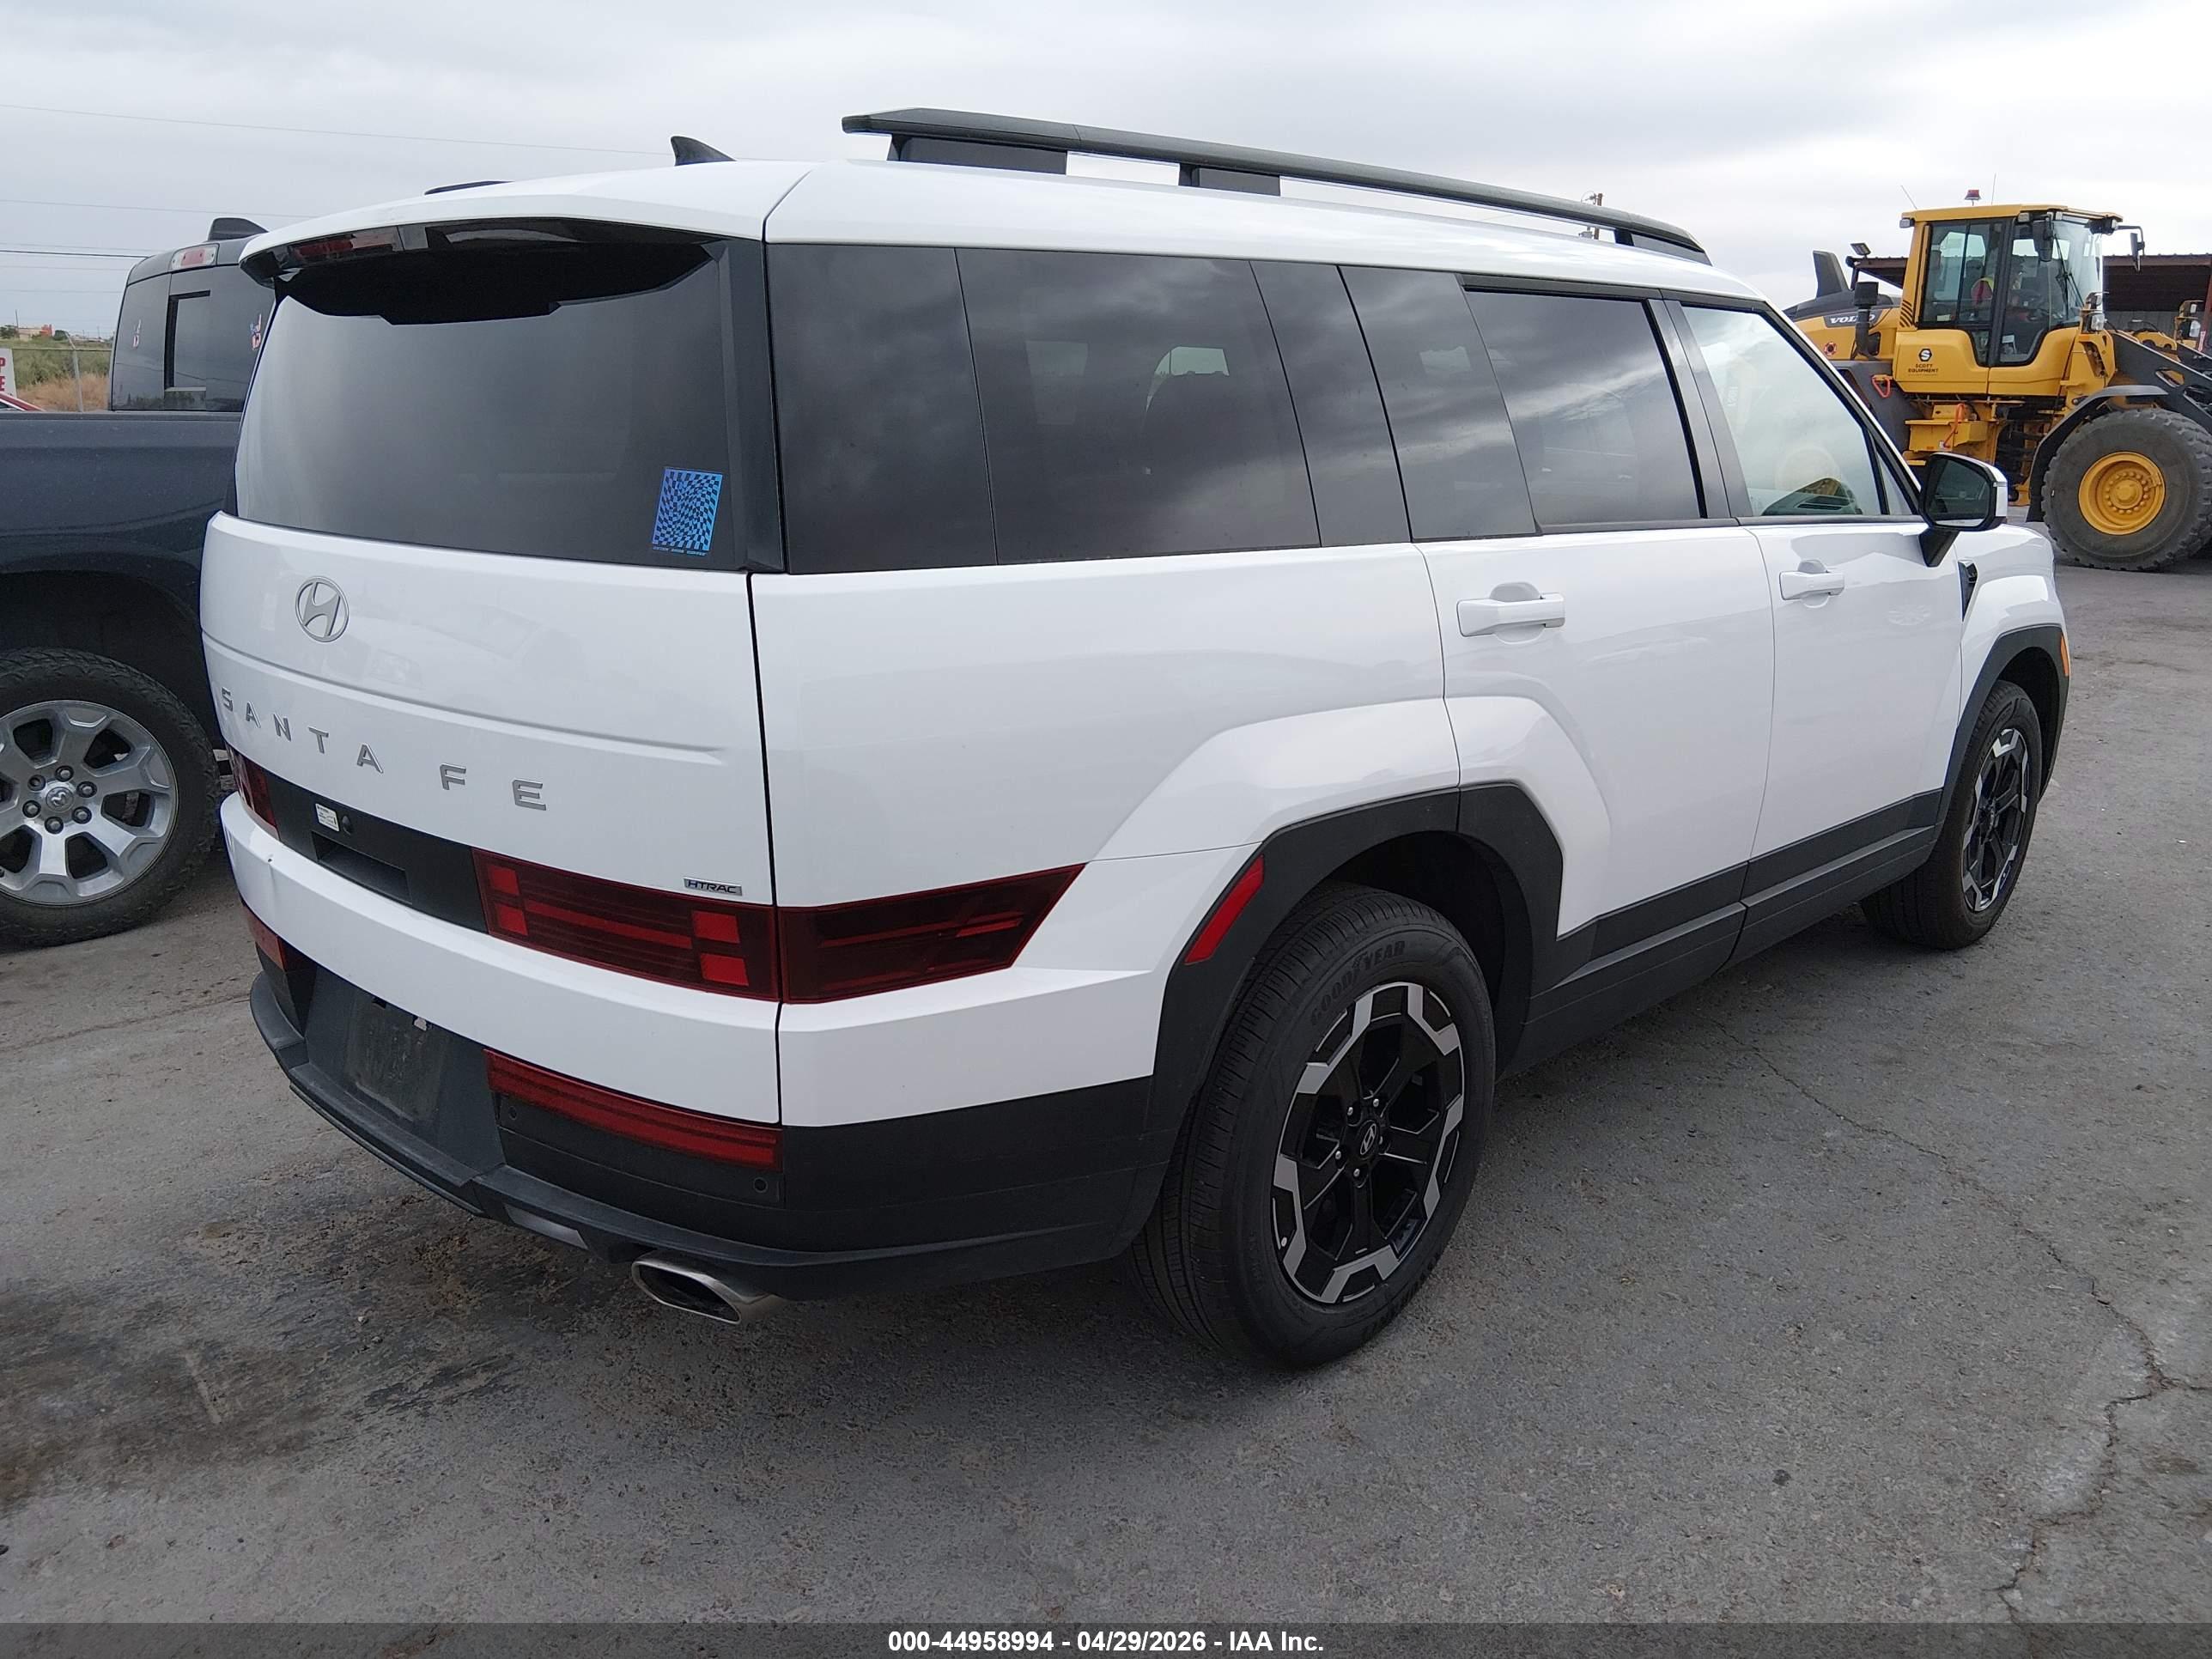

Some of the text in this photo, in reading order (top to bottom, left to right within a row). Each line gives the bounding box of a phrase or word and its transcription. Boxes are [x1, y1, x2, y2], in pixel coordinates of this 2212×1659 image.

[1830, 314, 1876, 324] VOLO
[222, 687, 547, 811] SANTA FE
[687, 878, 737, 894] HTRAC
[1311, 940, 1406, 1025] GOODYEAR
